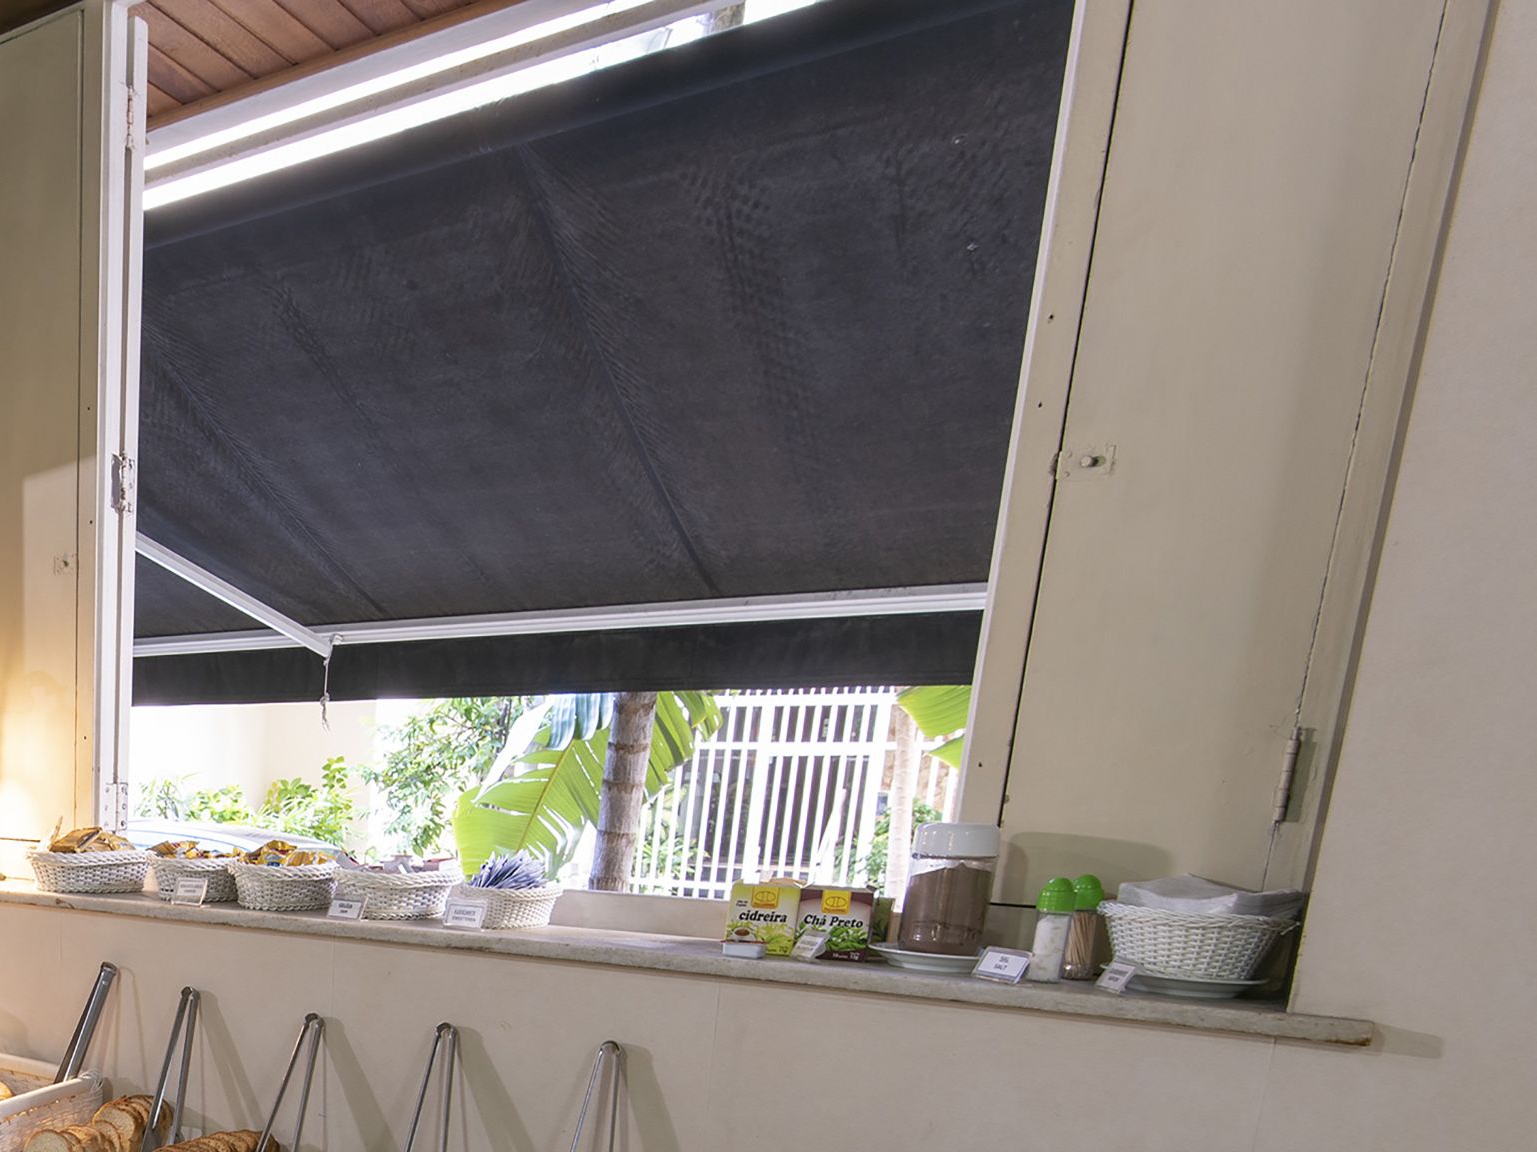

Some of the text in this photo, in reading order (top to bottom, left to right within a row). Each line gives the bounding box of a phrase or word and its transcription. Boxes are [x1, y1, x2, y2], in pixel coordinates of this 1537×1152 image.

[739, 910, 788, 923] cidreira
[804, 914, 864, 929] Chá Preto
[993, 963, 1008, 971] SALT
